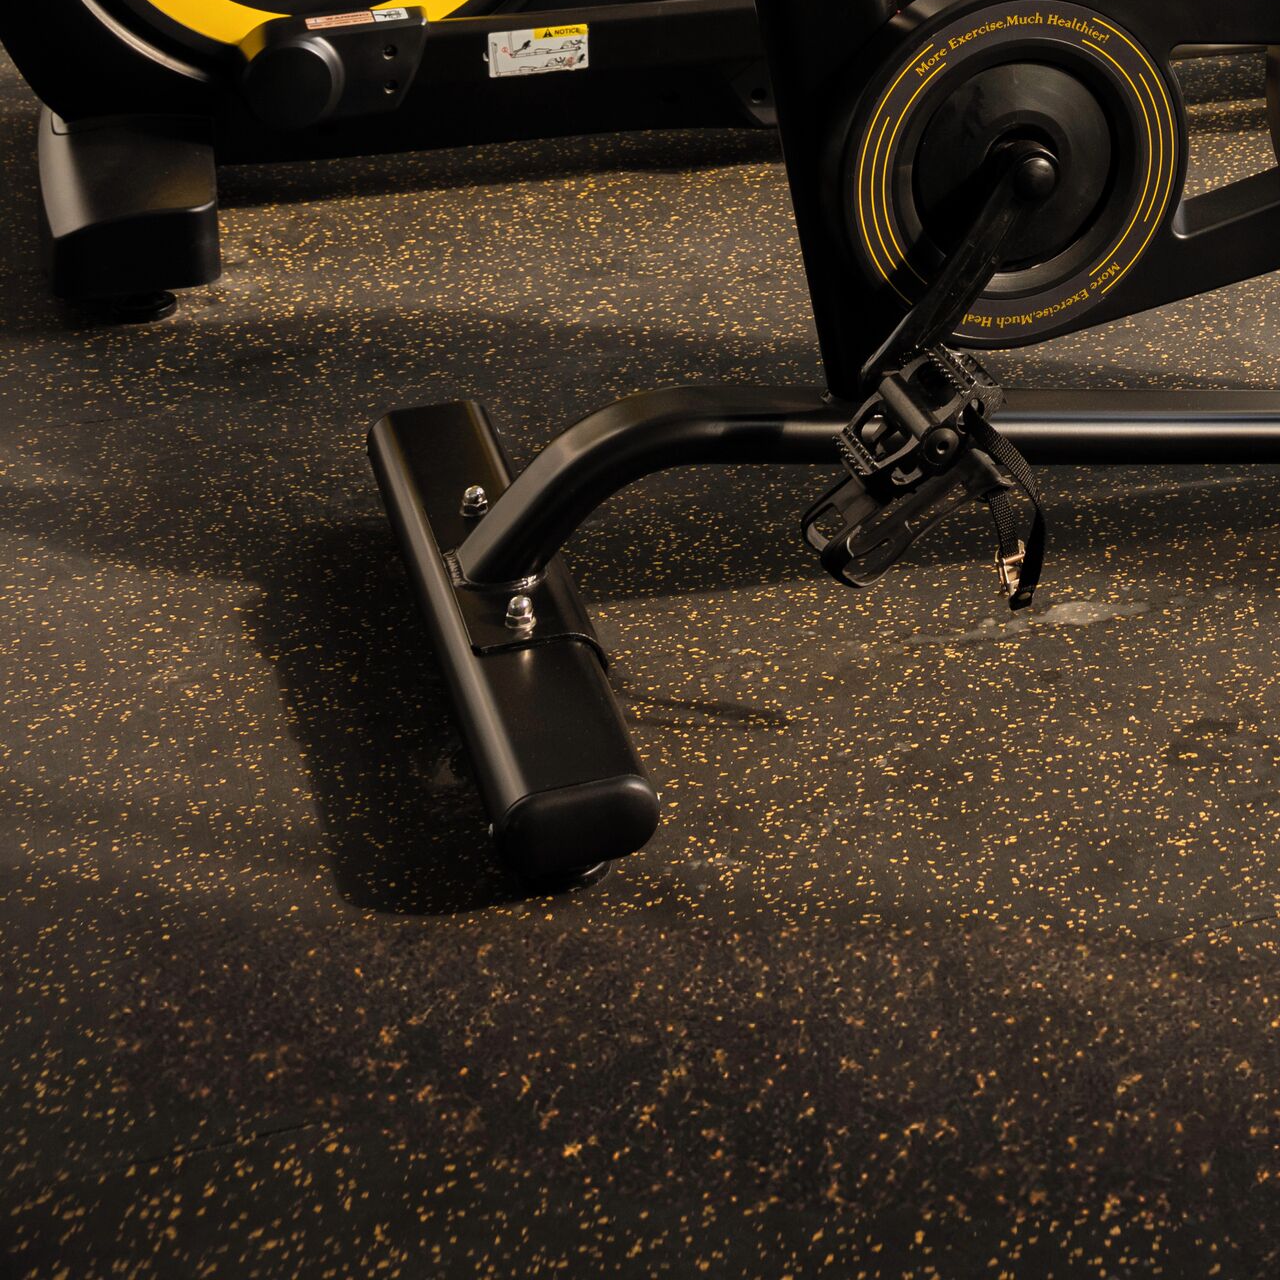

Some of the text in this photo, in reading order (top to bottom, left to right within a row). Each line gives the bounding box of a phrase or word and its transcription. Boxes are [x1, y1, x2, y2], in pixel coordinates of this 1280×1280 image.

[554, 27, 580, 36] NOTICE
[915, 48, 948, 77] More
[1047, 14, 1110, 44] Healthier!
[1089, 261, 1121, 290] More
